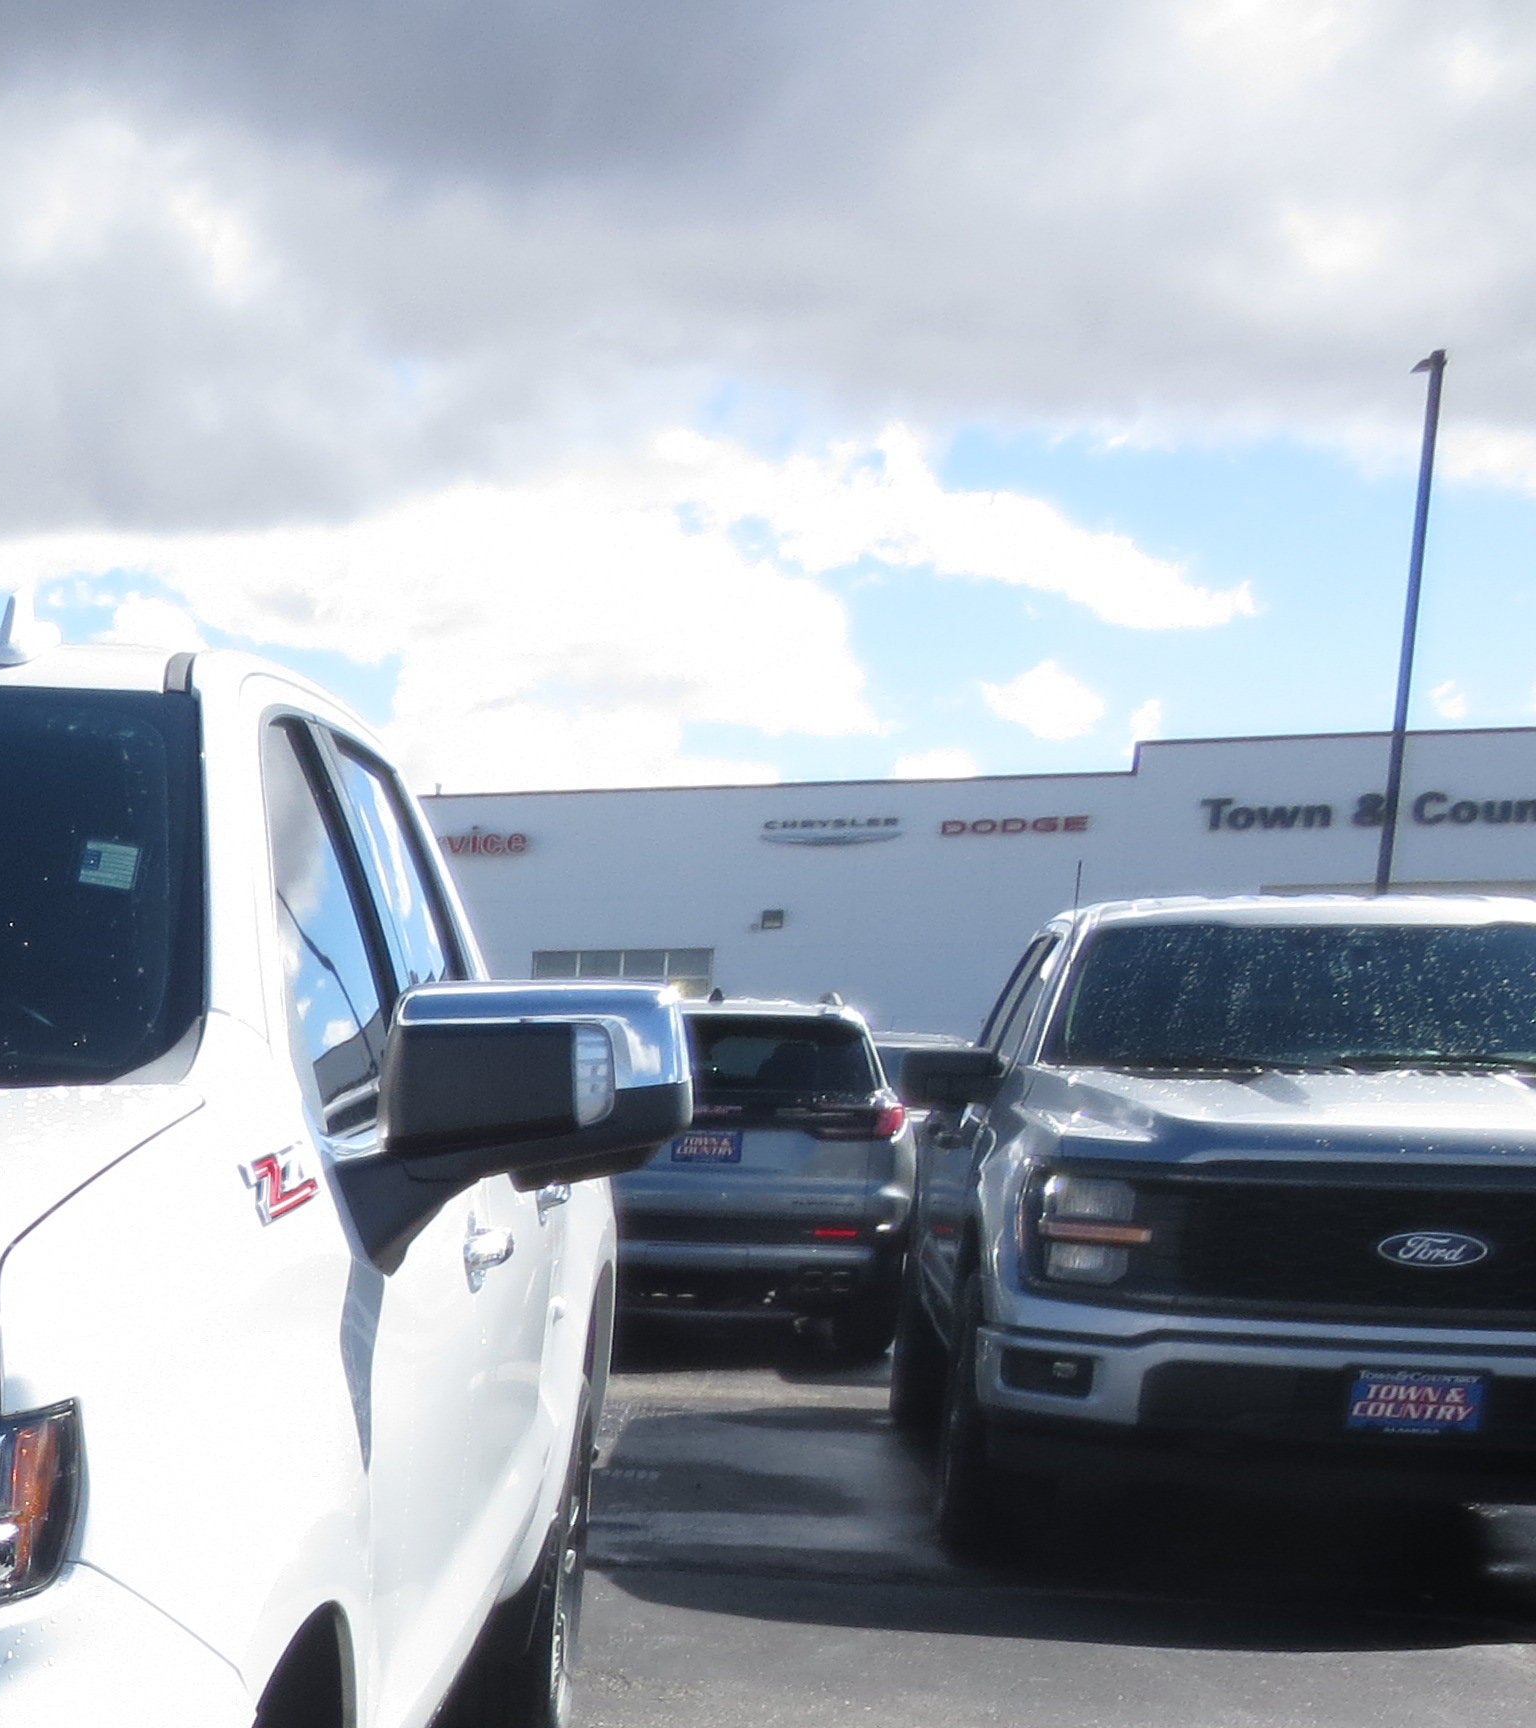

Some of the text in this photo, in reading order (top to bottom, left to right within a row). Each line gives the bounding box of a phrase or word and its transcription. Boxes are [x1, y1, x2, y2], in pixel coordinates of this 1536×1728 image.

[763, 816, 900, 831] CHRYSLER
[939, 815, 1090, 836] DODGE
[1202, 798, 1332, 832] Town
[438, 825, 529, 855] vice
[1398, 1236, 1468, 1261] Ford
[1366, 1384, 1468, 1403] TOWN &
[1352, 1401, 1473, 1421] COUNTRY
